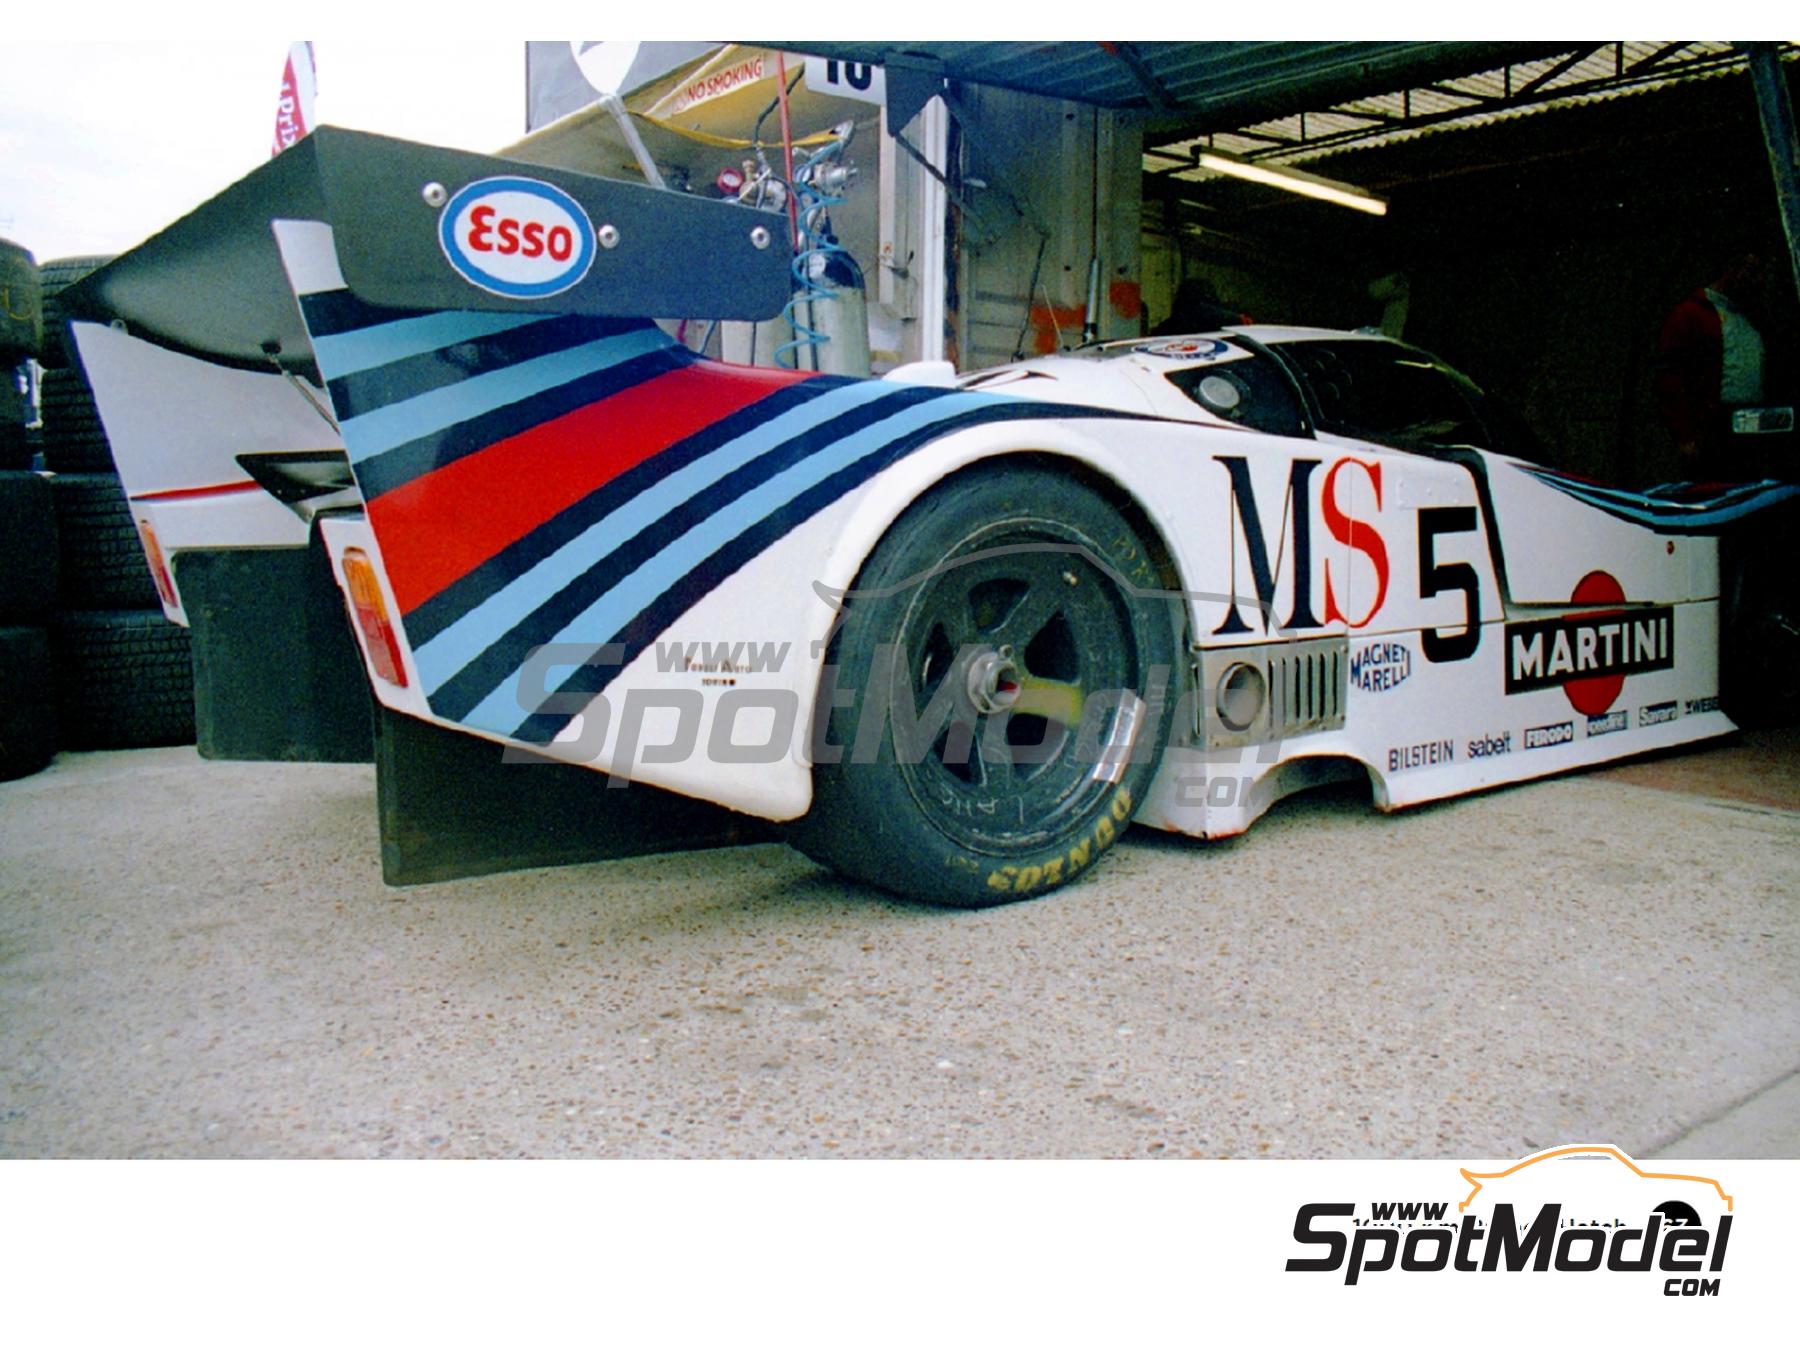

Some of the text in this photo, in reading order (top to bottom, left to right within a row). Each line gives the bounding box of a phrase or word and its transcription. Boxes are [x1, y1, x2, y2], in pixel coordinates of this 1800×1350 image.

[688, 57, 762, 102] NO SMOKING
[468, 205, 572, 262] Esso
[1212, 455, 1389, 635] MS
[1418, 506, 1481, 663] 5
[1512, 617, 1668, 681] MARTINI
[1389, 739, 1453, 771] BILSTEIN
[1468, 731, 1511, 759] sabelt
[1526, 723, 1573, 748] FERODO
